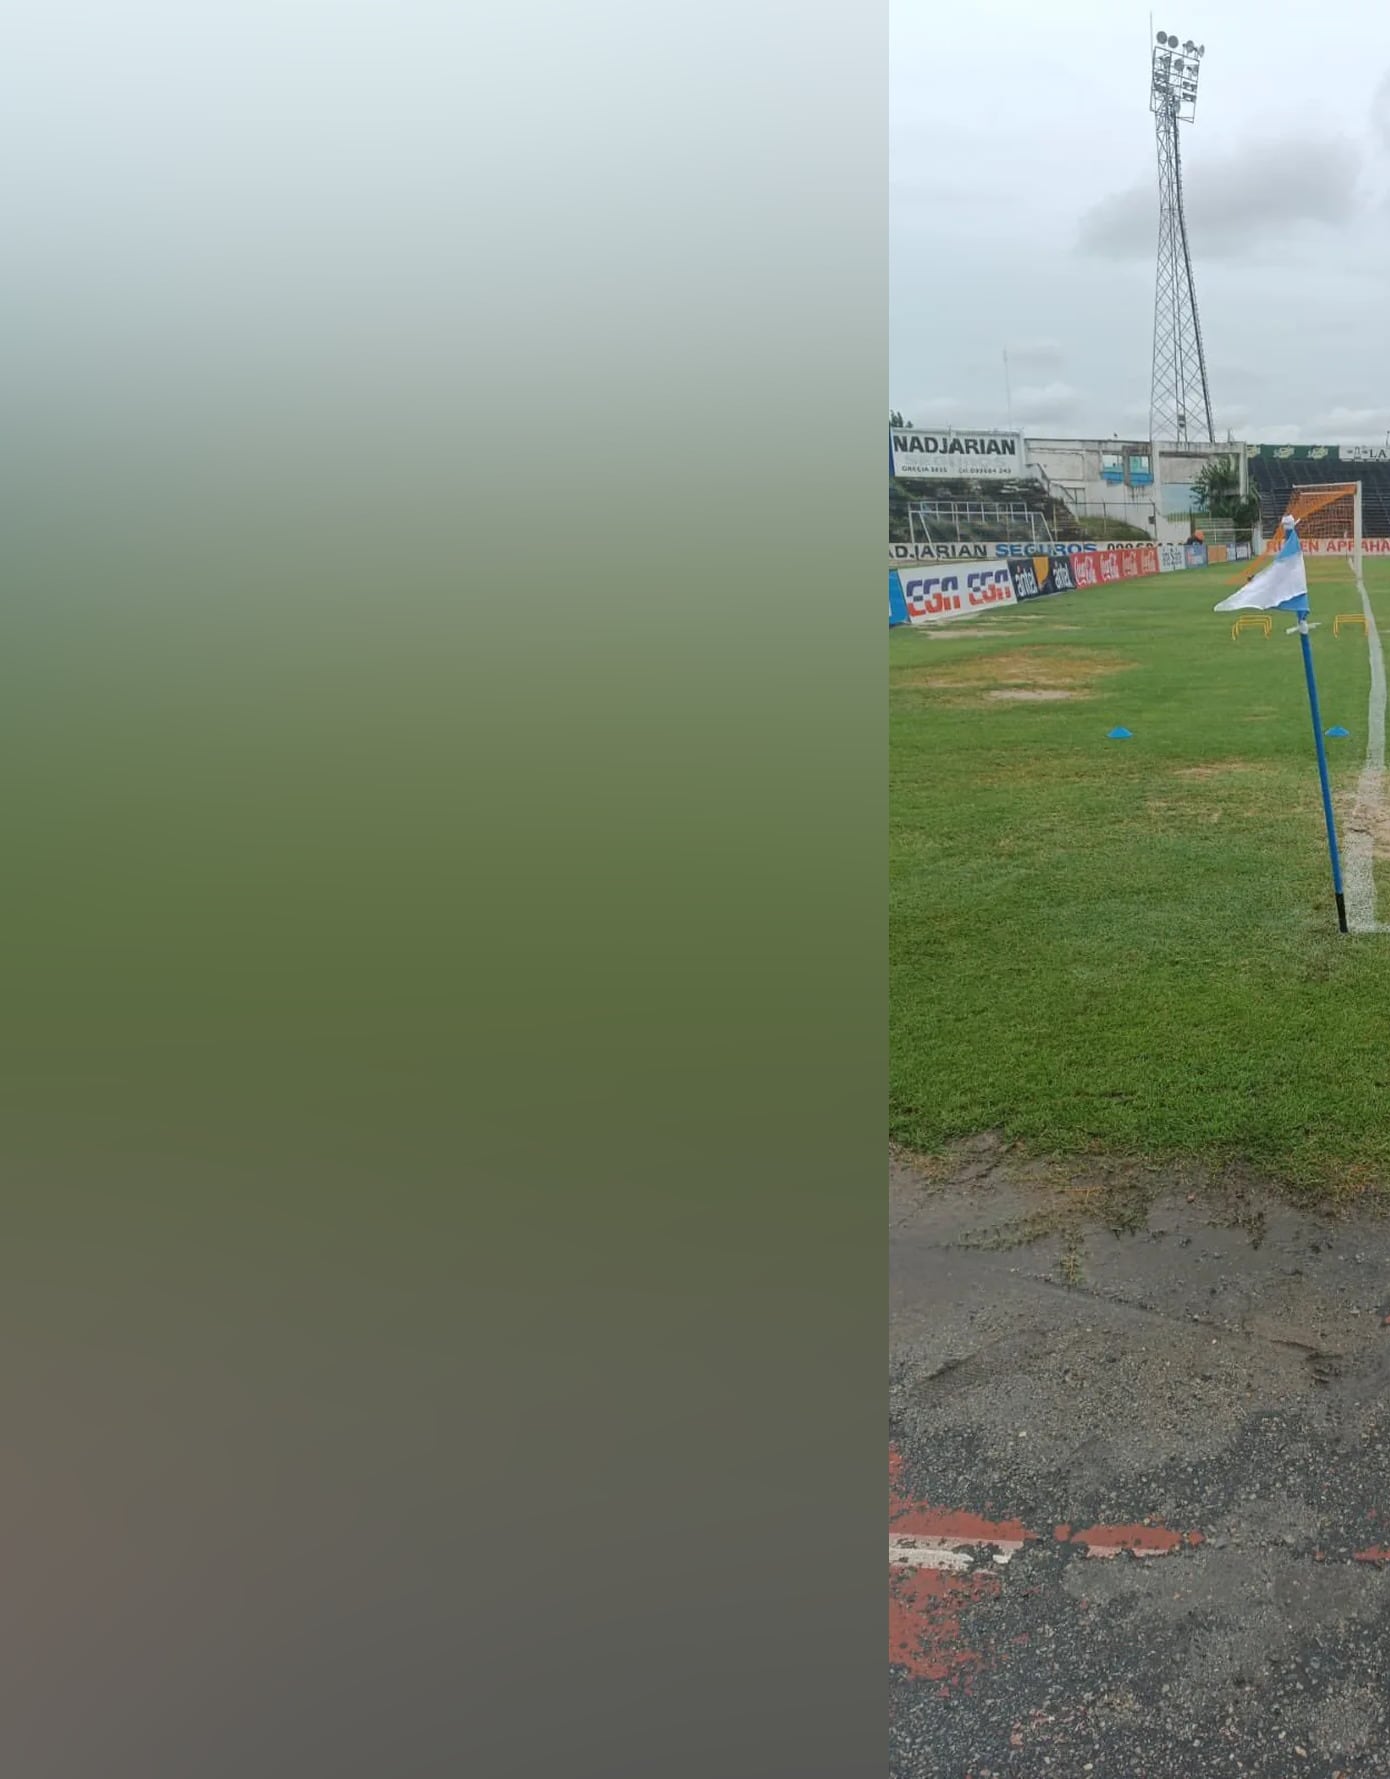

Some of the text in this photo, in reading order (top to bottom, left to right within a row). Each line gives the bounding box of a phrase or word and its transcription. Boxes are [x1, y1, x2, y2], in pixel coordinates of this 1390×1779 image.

[892, 435, 1016, 455] NADJARIAN
[1369, 449, 1387, 458] LA
[889, 545, 987, 559] DJARIAN
[995, 543, 1097, 557] SEGUROS
[1015, 565, 1038, 597] antel
[1053, 562, 1073, 590] antel
